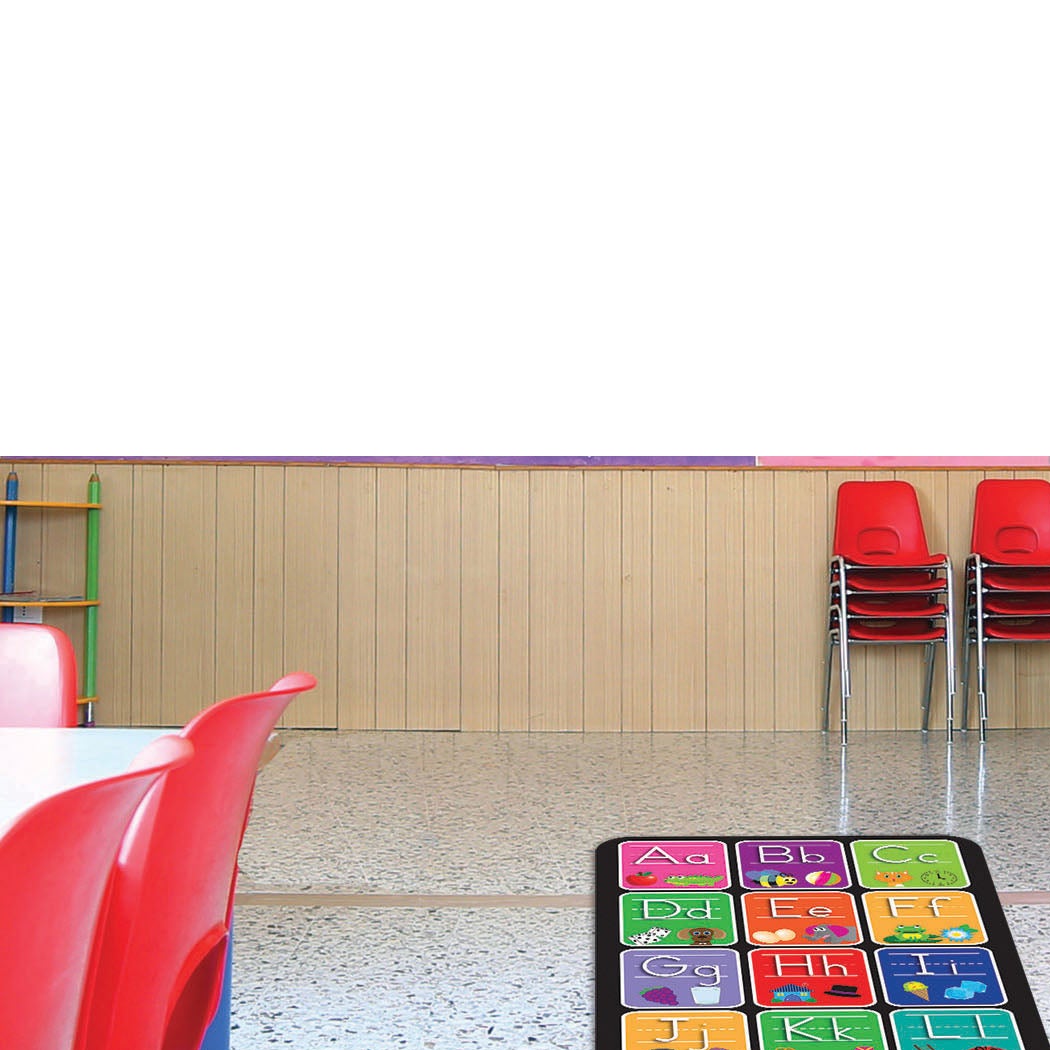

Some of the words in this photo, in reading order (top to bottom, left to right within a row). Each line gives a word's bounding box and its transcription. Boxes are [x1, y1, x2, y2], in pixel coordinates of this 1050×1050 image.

[634, 846, 709, 865] Aa
[759, 846, 825, 864] Bb
[872, 845, 939, 864] Cc
[643, 899, 712, 920] Dd
[770, 897, 833, 918] Ee
[888, 897, 951, 917] Ff
[642, 956, 720, 986] Gg
[775, 955, 848, 976] Hh
[911, 953, 957, 975] Ii
[783, 1017, 858, 1042] Kk
[922, 1014, 987, 1039] Ll
